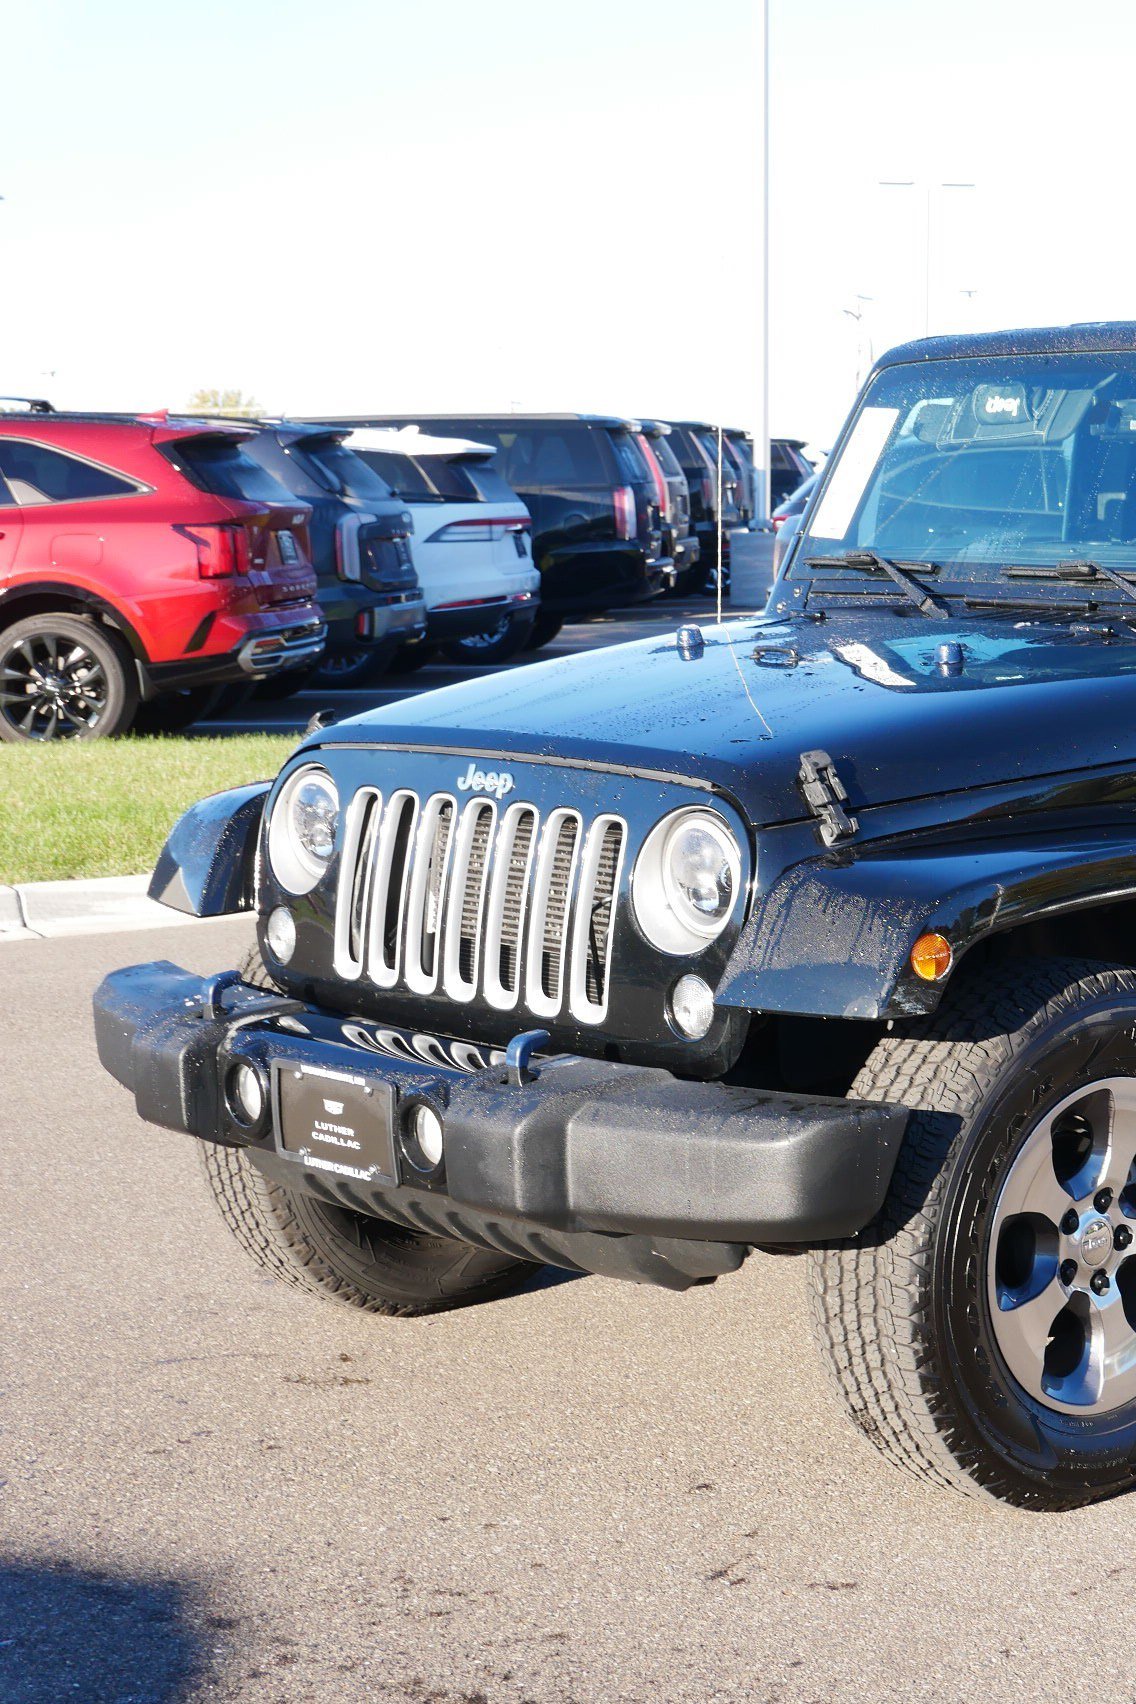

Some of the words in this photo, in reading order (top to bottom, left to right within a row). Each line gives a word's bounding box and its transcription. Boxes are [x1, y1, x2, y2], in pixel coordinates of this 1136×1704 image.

[456, 763, 514, 800] Jeep
[314, 1120, 355, 1137] LUTHER
[311, 1131, 361, 1149] CADILLAC
